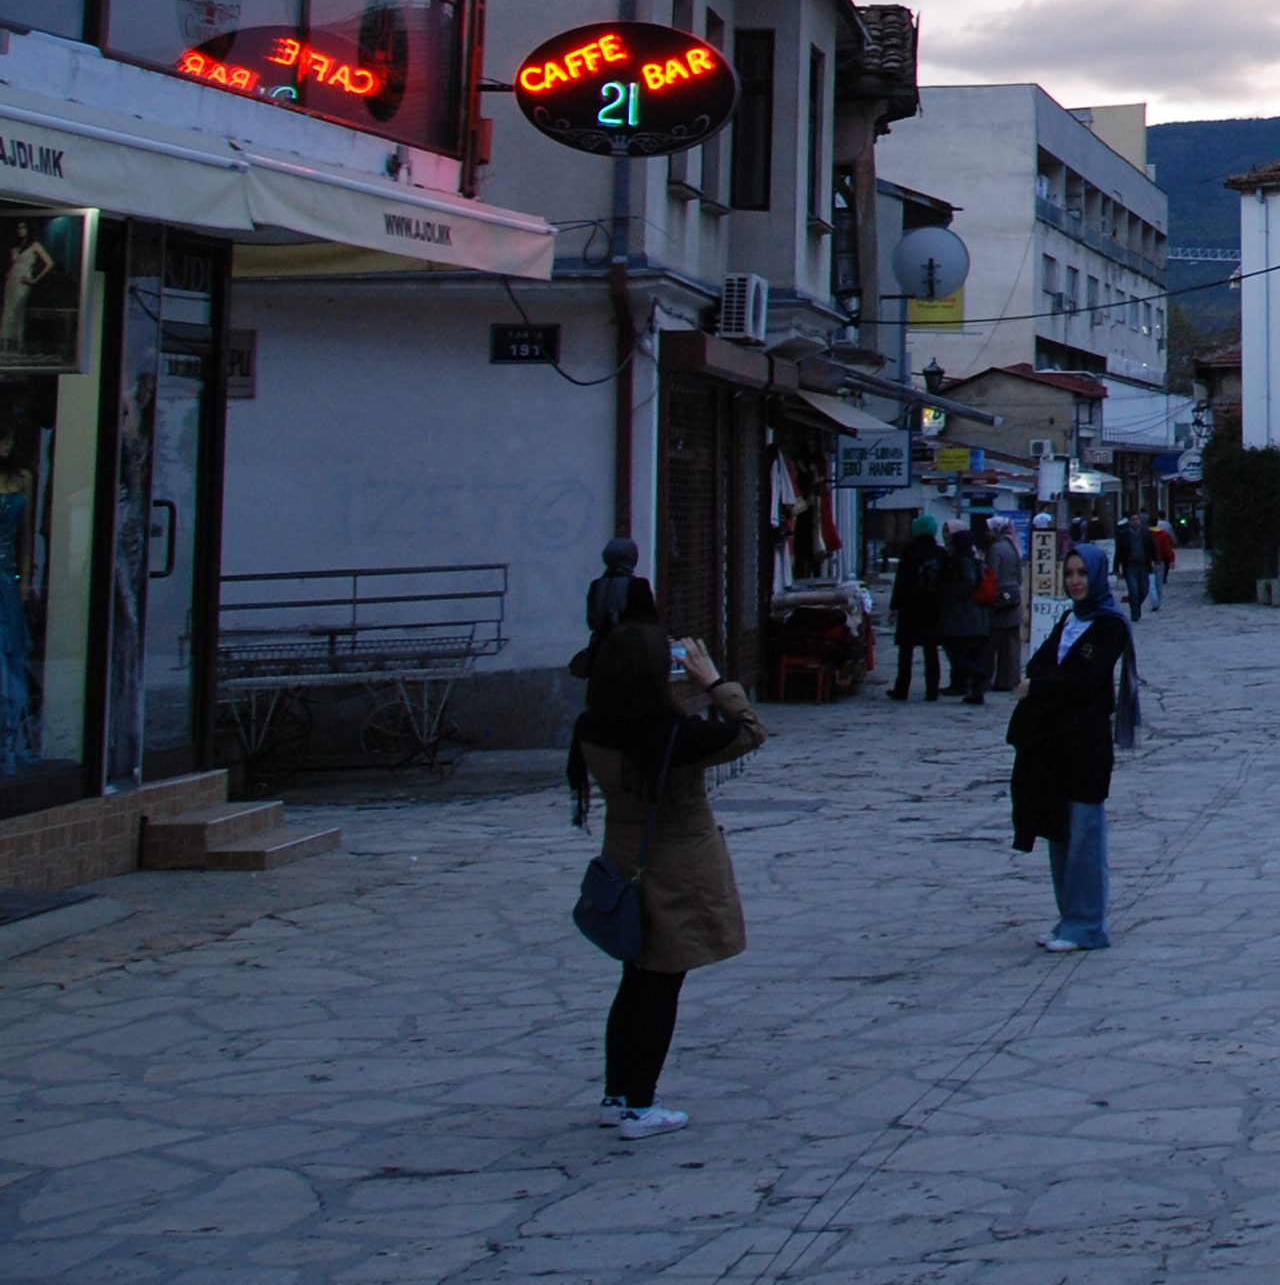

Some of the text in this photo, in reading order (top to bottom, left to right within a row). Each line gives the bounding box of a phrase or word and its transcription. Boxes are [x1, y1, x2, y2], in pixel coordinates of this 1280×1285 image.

[519, 33, 715, 91] CAFFE BAR
[597, 81, 639, 127] 21
